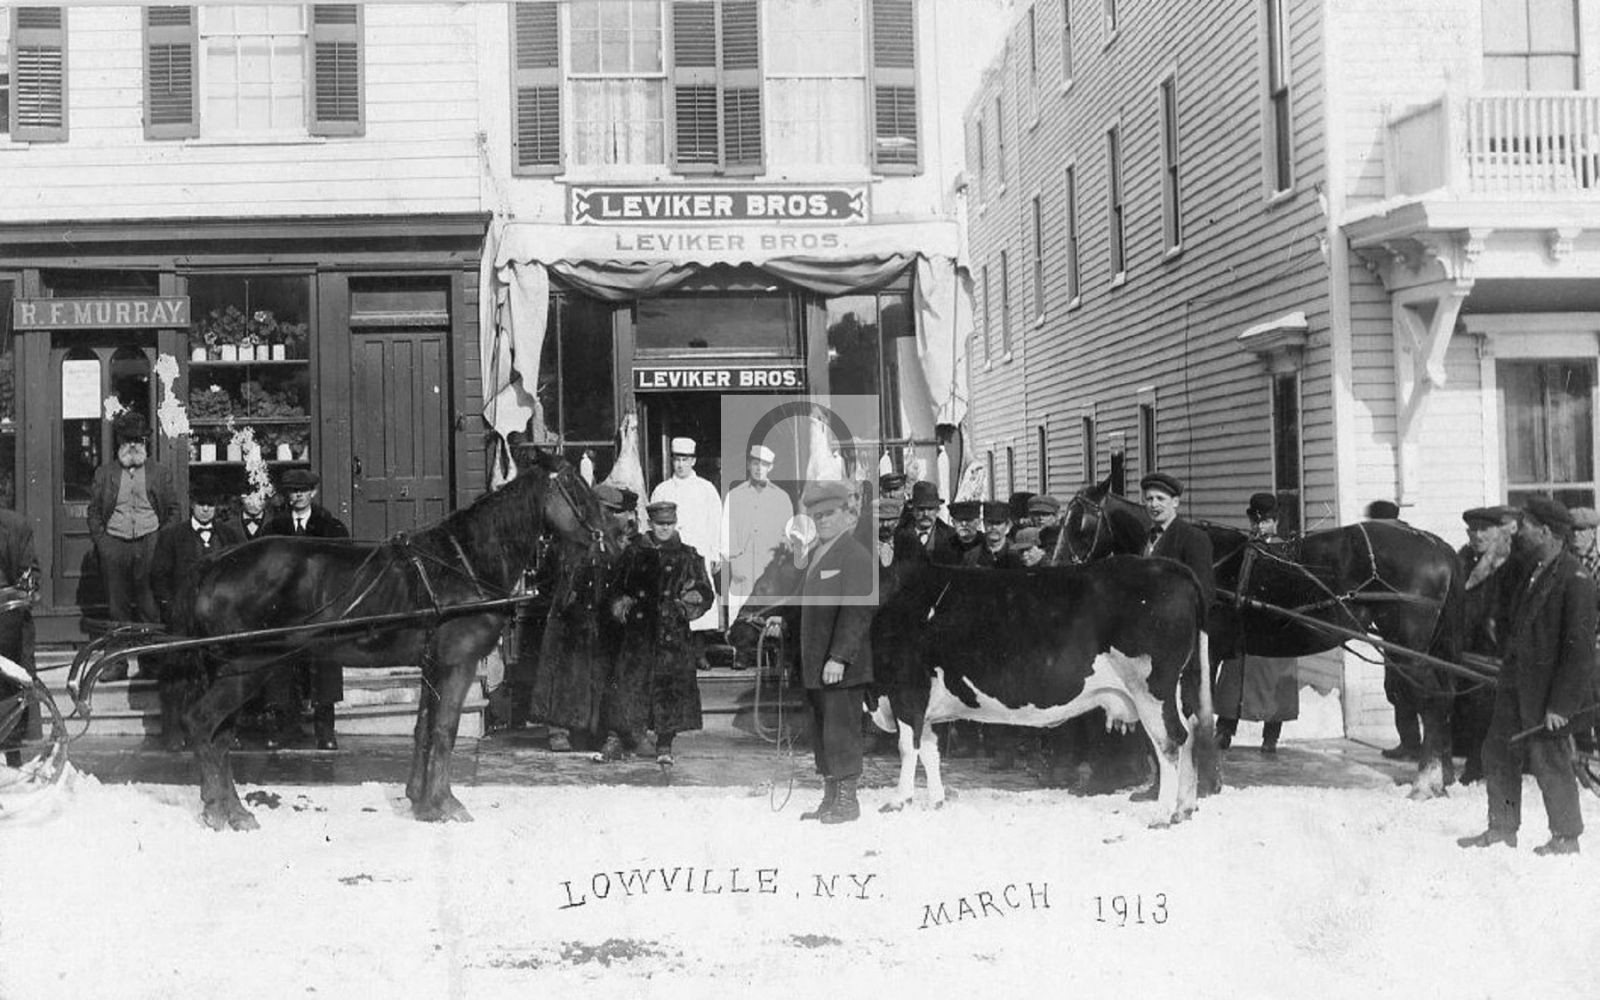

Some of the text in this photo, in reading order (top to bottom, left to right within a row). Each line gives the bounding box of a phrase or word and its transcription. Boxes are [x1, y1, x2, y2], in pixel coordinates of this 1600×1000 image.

[602, 194, 838, 218] LEVIKER BROS.
[615, 233, 850, 252] LEVIKER BROS.
[21, 301, 185, 325] R. F. MURRAY.
[638, 371, 804, 388] LEVIKER BROS.
